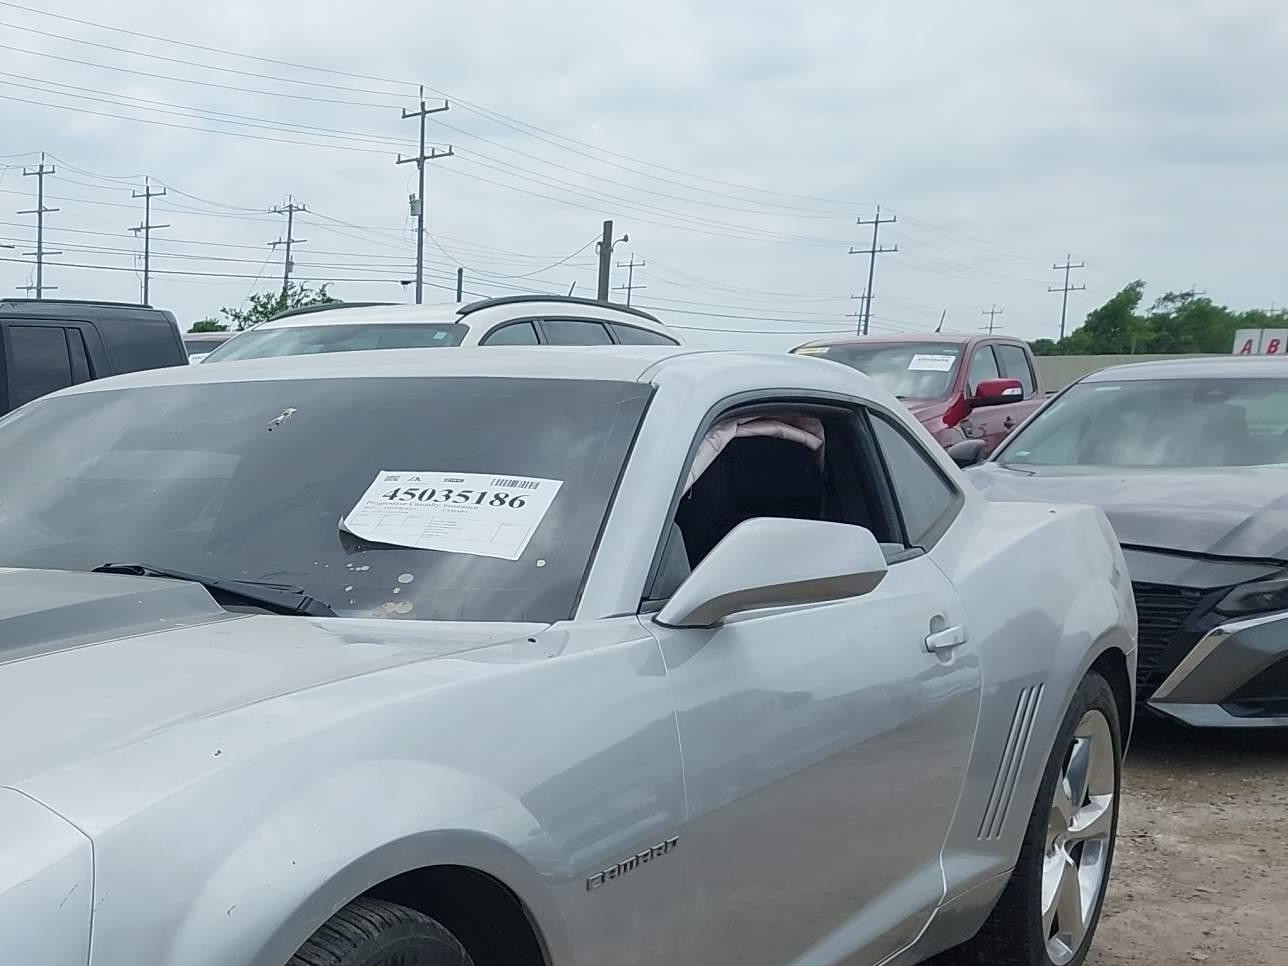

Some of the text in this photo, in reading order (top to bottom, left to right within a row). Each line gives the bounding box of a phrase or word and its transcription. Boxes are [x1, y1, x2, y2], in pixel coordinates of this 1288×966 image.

[1240, 338, 1281, 354] A B
[381, 486, 531, 509] 45035186
